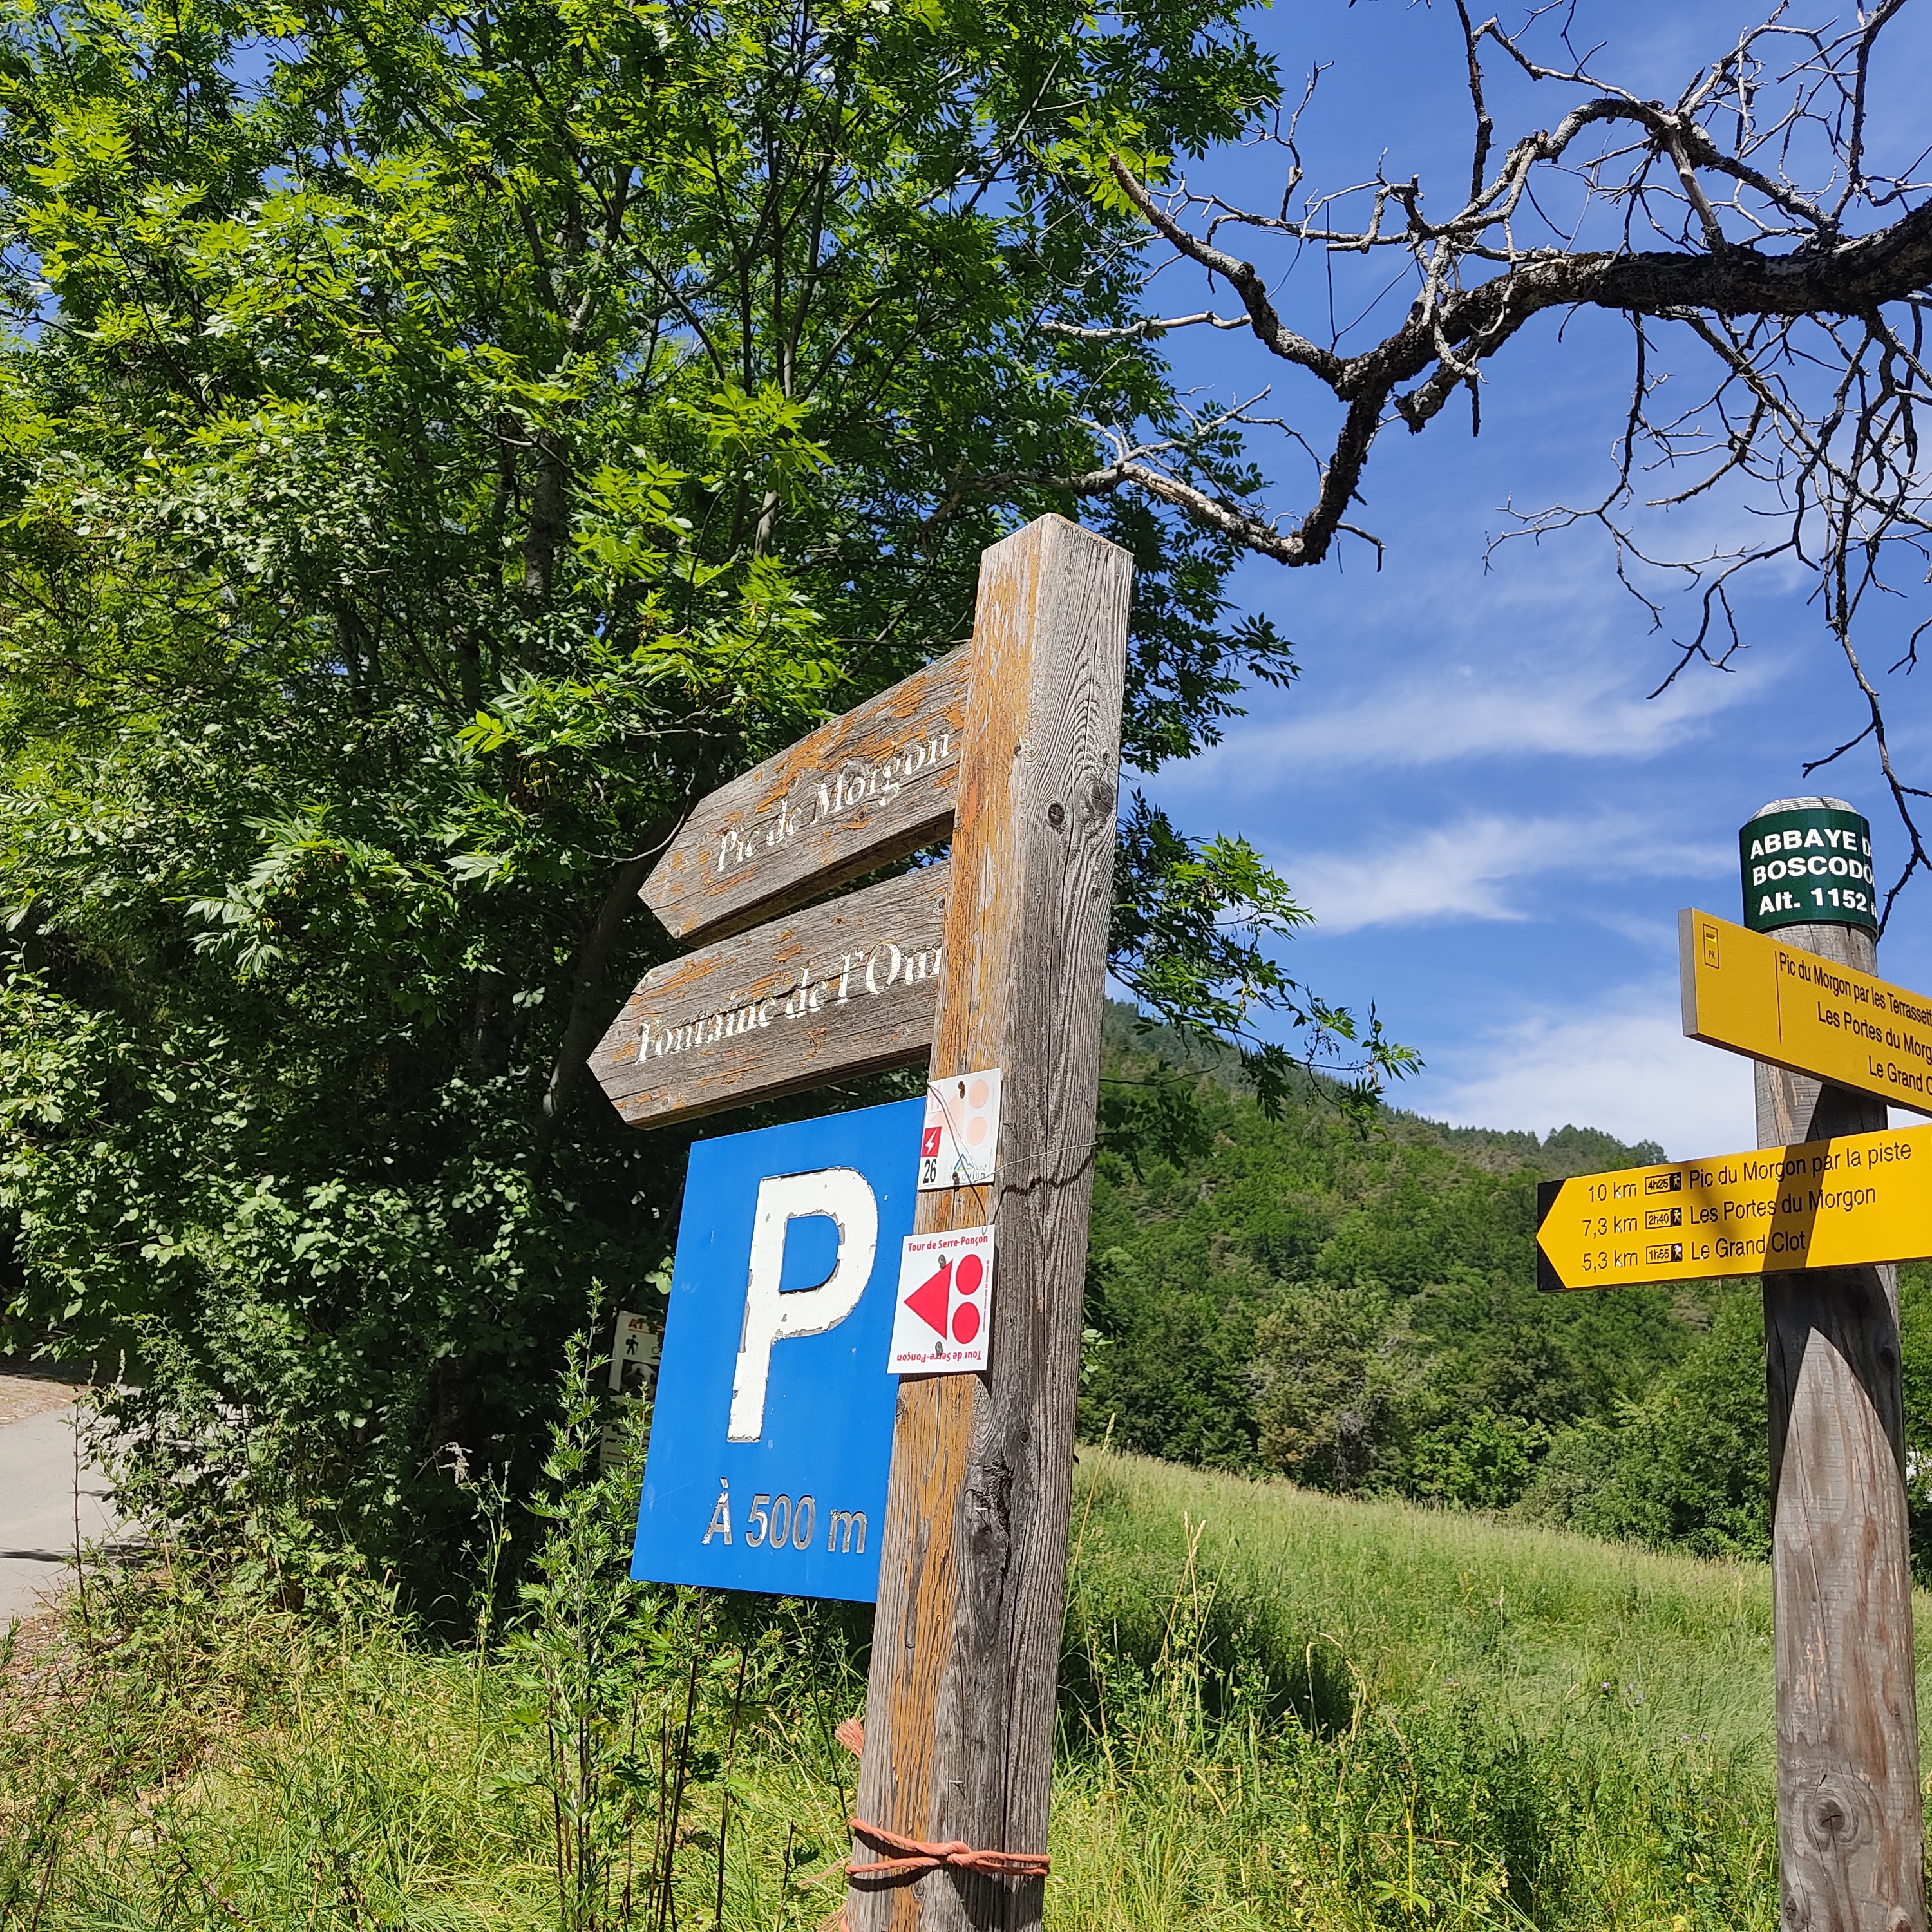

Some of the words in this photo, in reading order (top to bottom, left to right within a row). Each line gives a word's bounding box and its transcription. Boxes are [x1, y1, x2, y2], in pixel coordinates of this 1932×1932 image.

[766, 800, 802, 846] de
[810, 734, 949, 825] Morgon
[1750, 828, 1857, 860] ABBAYE
[1759, 891, 1801, 916] Alt.
[1810, 887, 1868, 912] 1152
[1708, 949, 1716, 960] PR
[1779, 951, 1795, 976] Pic
[1798, 960, 1811, 981] du
[1814, 965, 1852, 997] Morgon
[1854, 984, 1869, 1004] par
[1871, 987, 1886, 1010] les
[635, 994, 776, 1065] Fontaine
[785, 960, 829, 1019] de
[1817, 1001, 1840, 1028] Les
[1844, 1010, 1882, 1043] Portes
[1886, 1028, 1900, 1050] du
[1868, 1055, 1884, 1079] Le
[1886, 1063, 1923, 1092] Grand
[923, 1158, 937, 1184] 26
[1588, 1184, 1607, 1202] 10
[1613, 1182, 1637, 1199] km
[1647, 1178, 1669, 1190] 4h25
[1689, 1169, 1713, 1189] Pic
[1718, 1165, 1737, 1185] du
[1743, 1159, 1806, 1182] Morgon
[1812, 1153, 1841, 1177] par
[1846, 1147, 1862, 1168] la
[1868, 1141, 1911, 1170] piste
[1582, 1217, 1607, 1239] 7,3
[1613, 1215, 1637, 1233] km
[1648, 1213, 1669, 1225] 2h40
[1690, 1205, 1718, 1224] Les
[1723, 1198, 1776, 1221] Portes
[1781, 1193, 1803, 1214] du
[1808, 1188, 1876, 1211] Morgon
[908, 1241, 925, 1251] Tour
[927, 1240, 936, 1249] de
[938, 1235, 988, 1249] Serre-Ponçon
[1582, 1251, 1607, 1273] 5,3
[1614, 1250, 1638, 1267] km
[1649, 1248, 1669, 1260] 1h55
[1691, 1241, 1710, 1260] Le
[1715, 1234, 1765, 1258] Grand
[1772, 1231, 1806, 1253] Clot
[727, 1166, 878, 1442] P
[897, 1351, 951, 1363] Serre-Ponçon
[953, 1352, 962, 1361] de
[965, 1350, 981, 1360] Tour
[701, 1476, 732, 1545] À
[745, 1493, 816, 1550] 500
[827, 1509, 867, 1553] m
